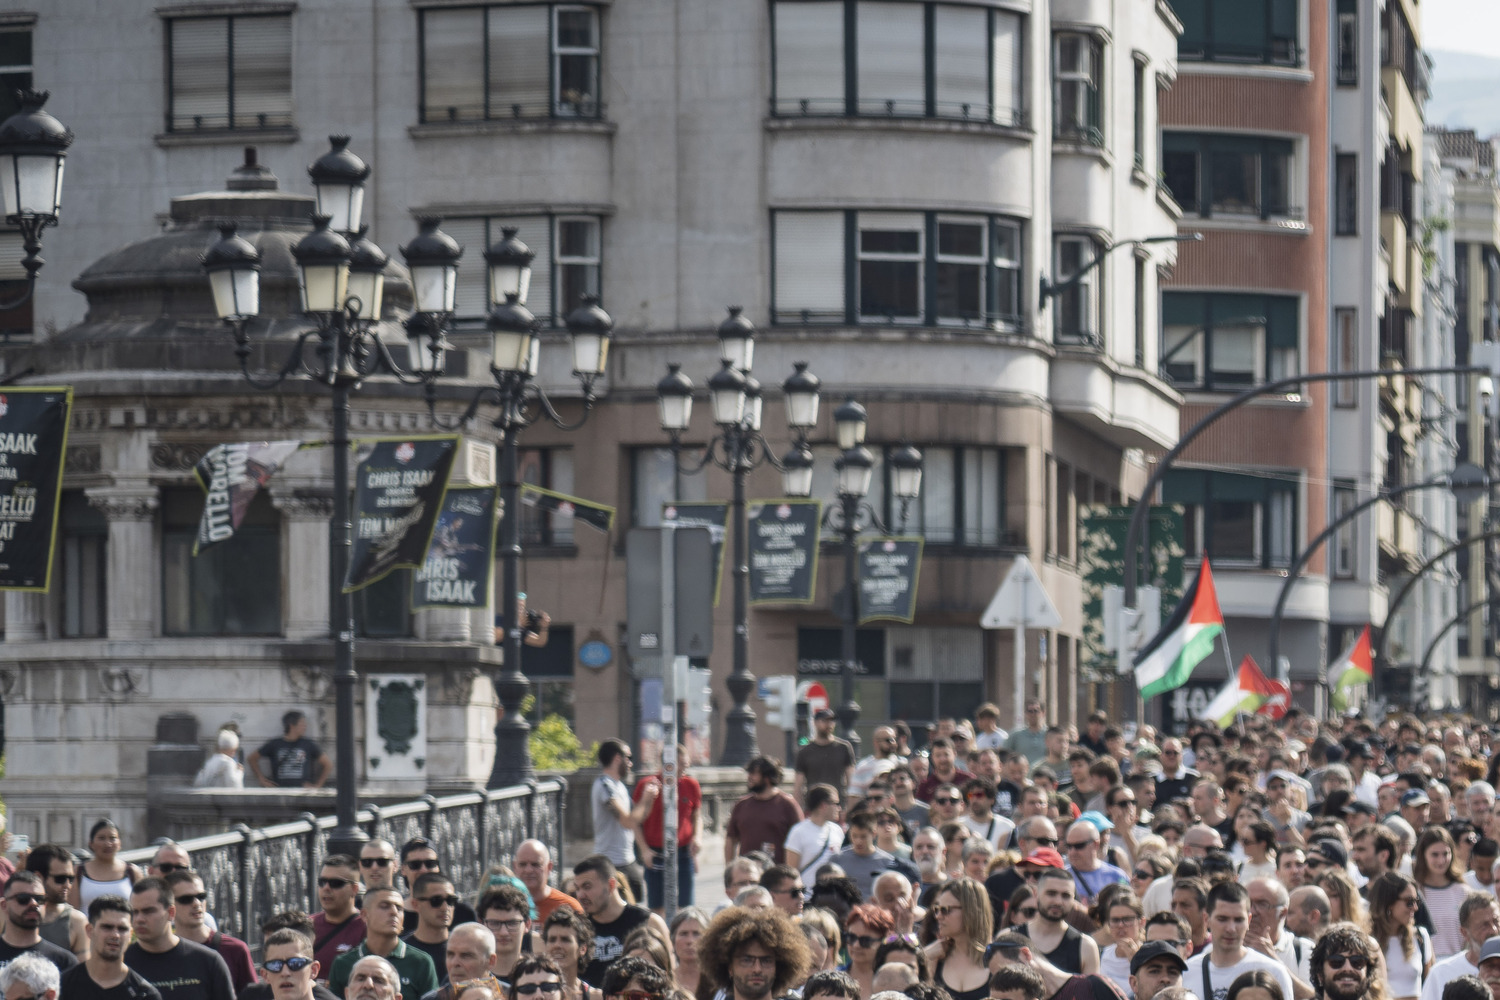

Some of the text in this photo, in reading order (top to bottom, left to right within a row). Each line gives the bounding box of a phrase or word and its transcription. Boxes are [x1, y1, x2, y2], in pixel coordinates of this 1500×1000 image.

[0, 434, 37, 454] SAAK
[367, 472, 400, 488] CHRIS
[0, 496, 36, 516] ELLO
[426, 580, 478, 603] ISAAK
[799, 659, 869, 675] CRYSAL
